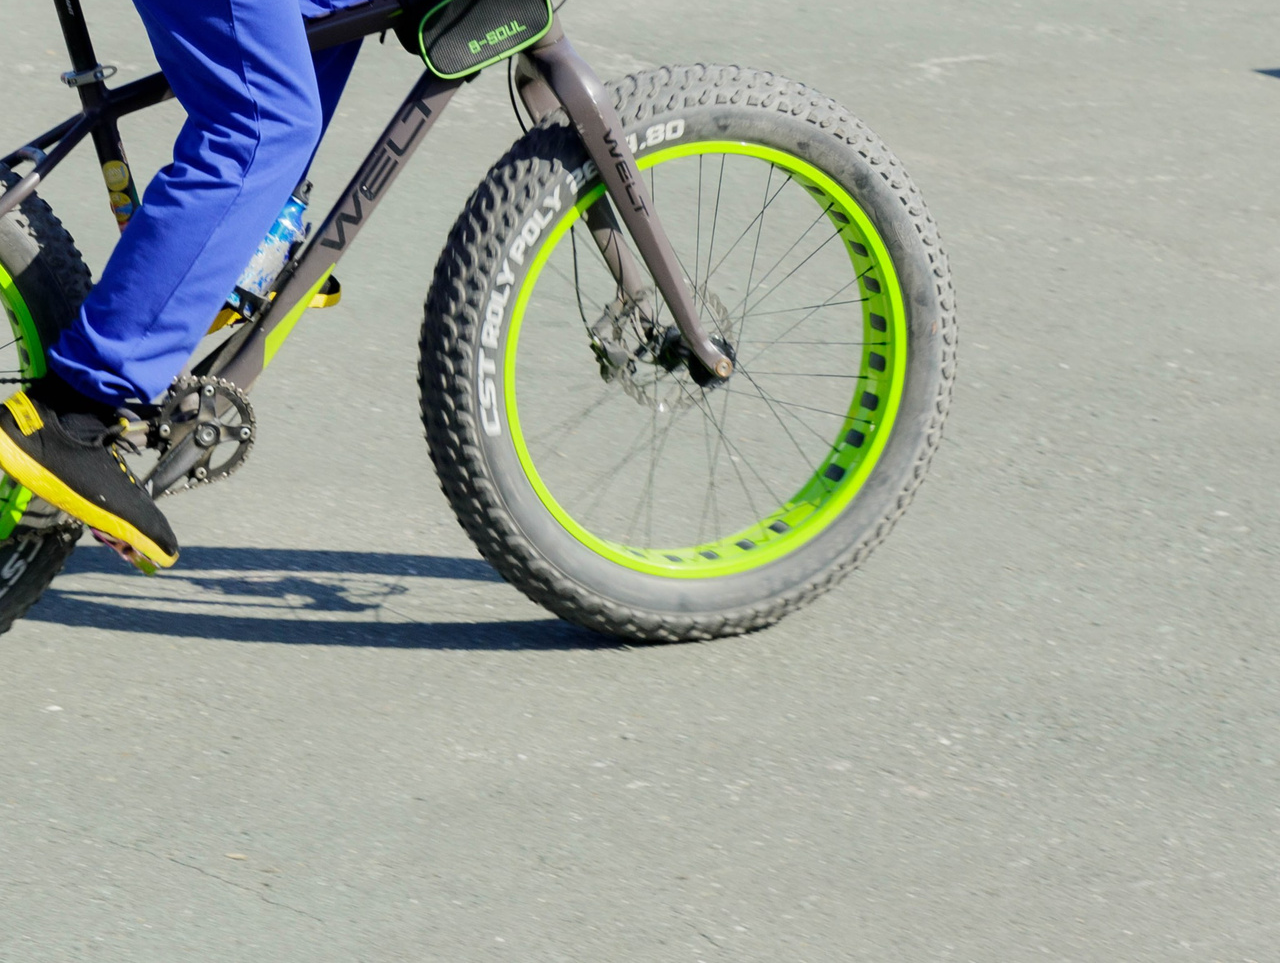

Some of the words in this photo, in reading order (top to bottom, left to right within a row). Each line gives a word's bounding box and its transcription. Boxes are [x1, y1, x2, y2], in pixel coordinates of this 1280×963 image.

[321, 98, 432, 251] WELT
[603, 128, 650, 217] WELT
[509, 184, 563, 266] POLY
[482, 259, 515, 349] ROLY
[478, 348, 502, 436] CST
